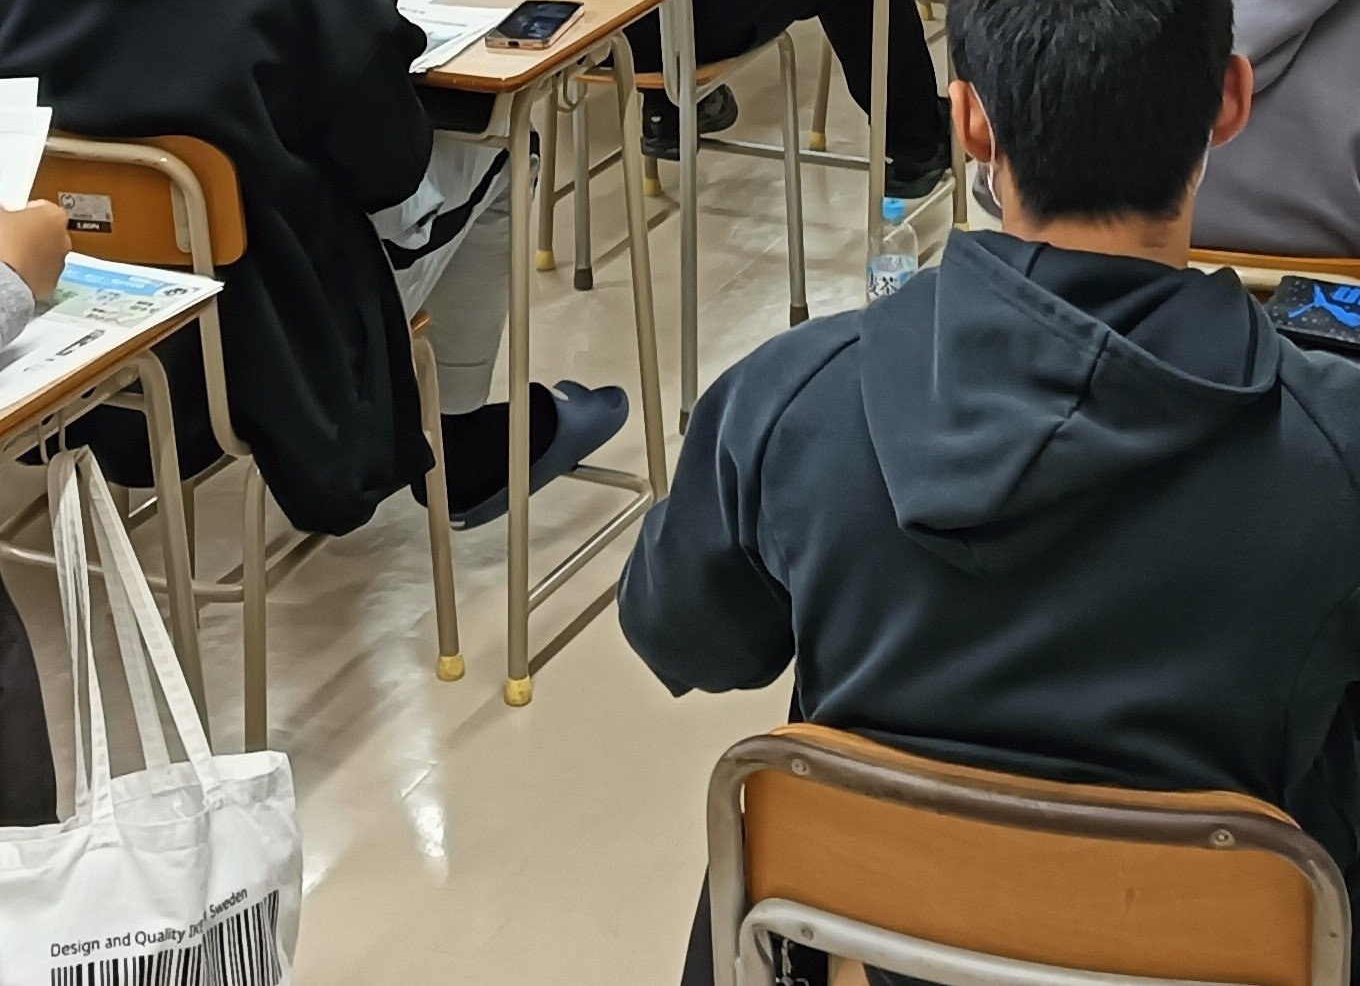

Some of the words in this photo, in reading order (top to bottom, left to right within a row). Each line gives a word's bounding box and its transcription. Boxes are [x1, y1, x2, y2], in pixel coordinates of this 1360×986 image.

[51, 939, 100, 957] Design
[105, 932, 131, 949] and
[134, 928, 186, 946] Quality
[209, 888, 248, 919] Sweden
